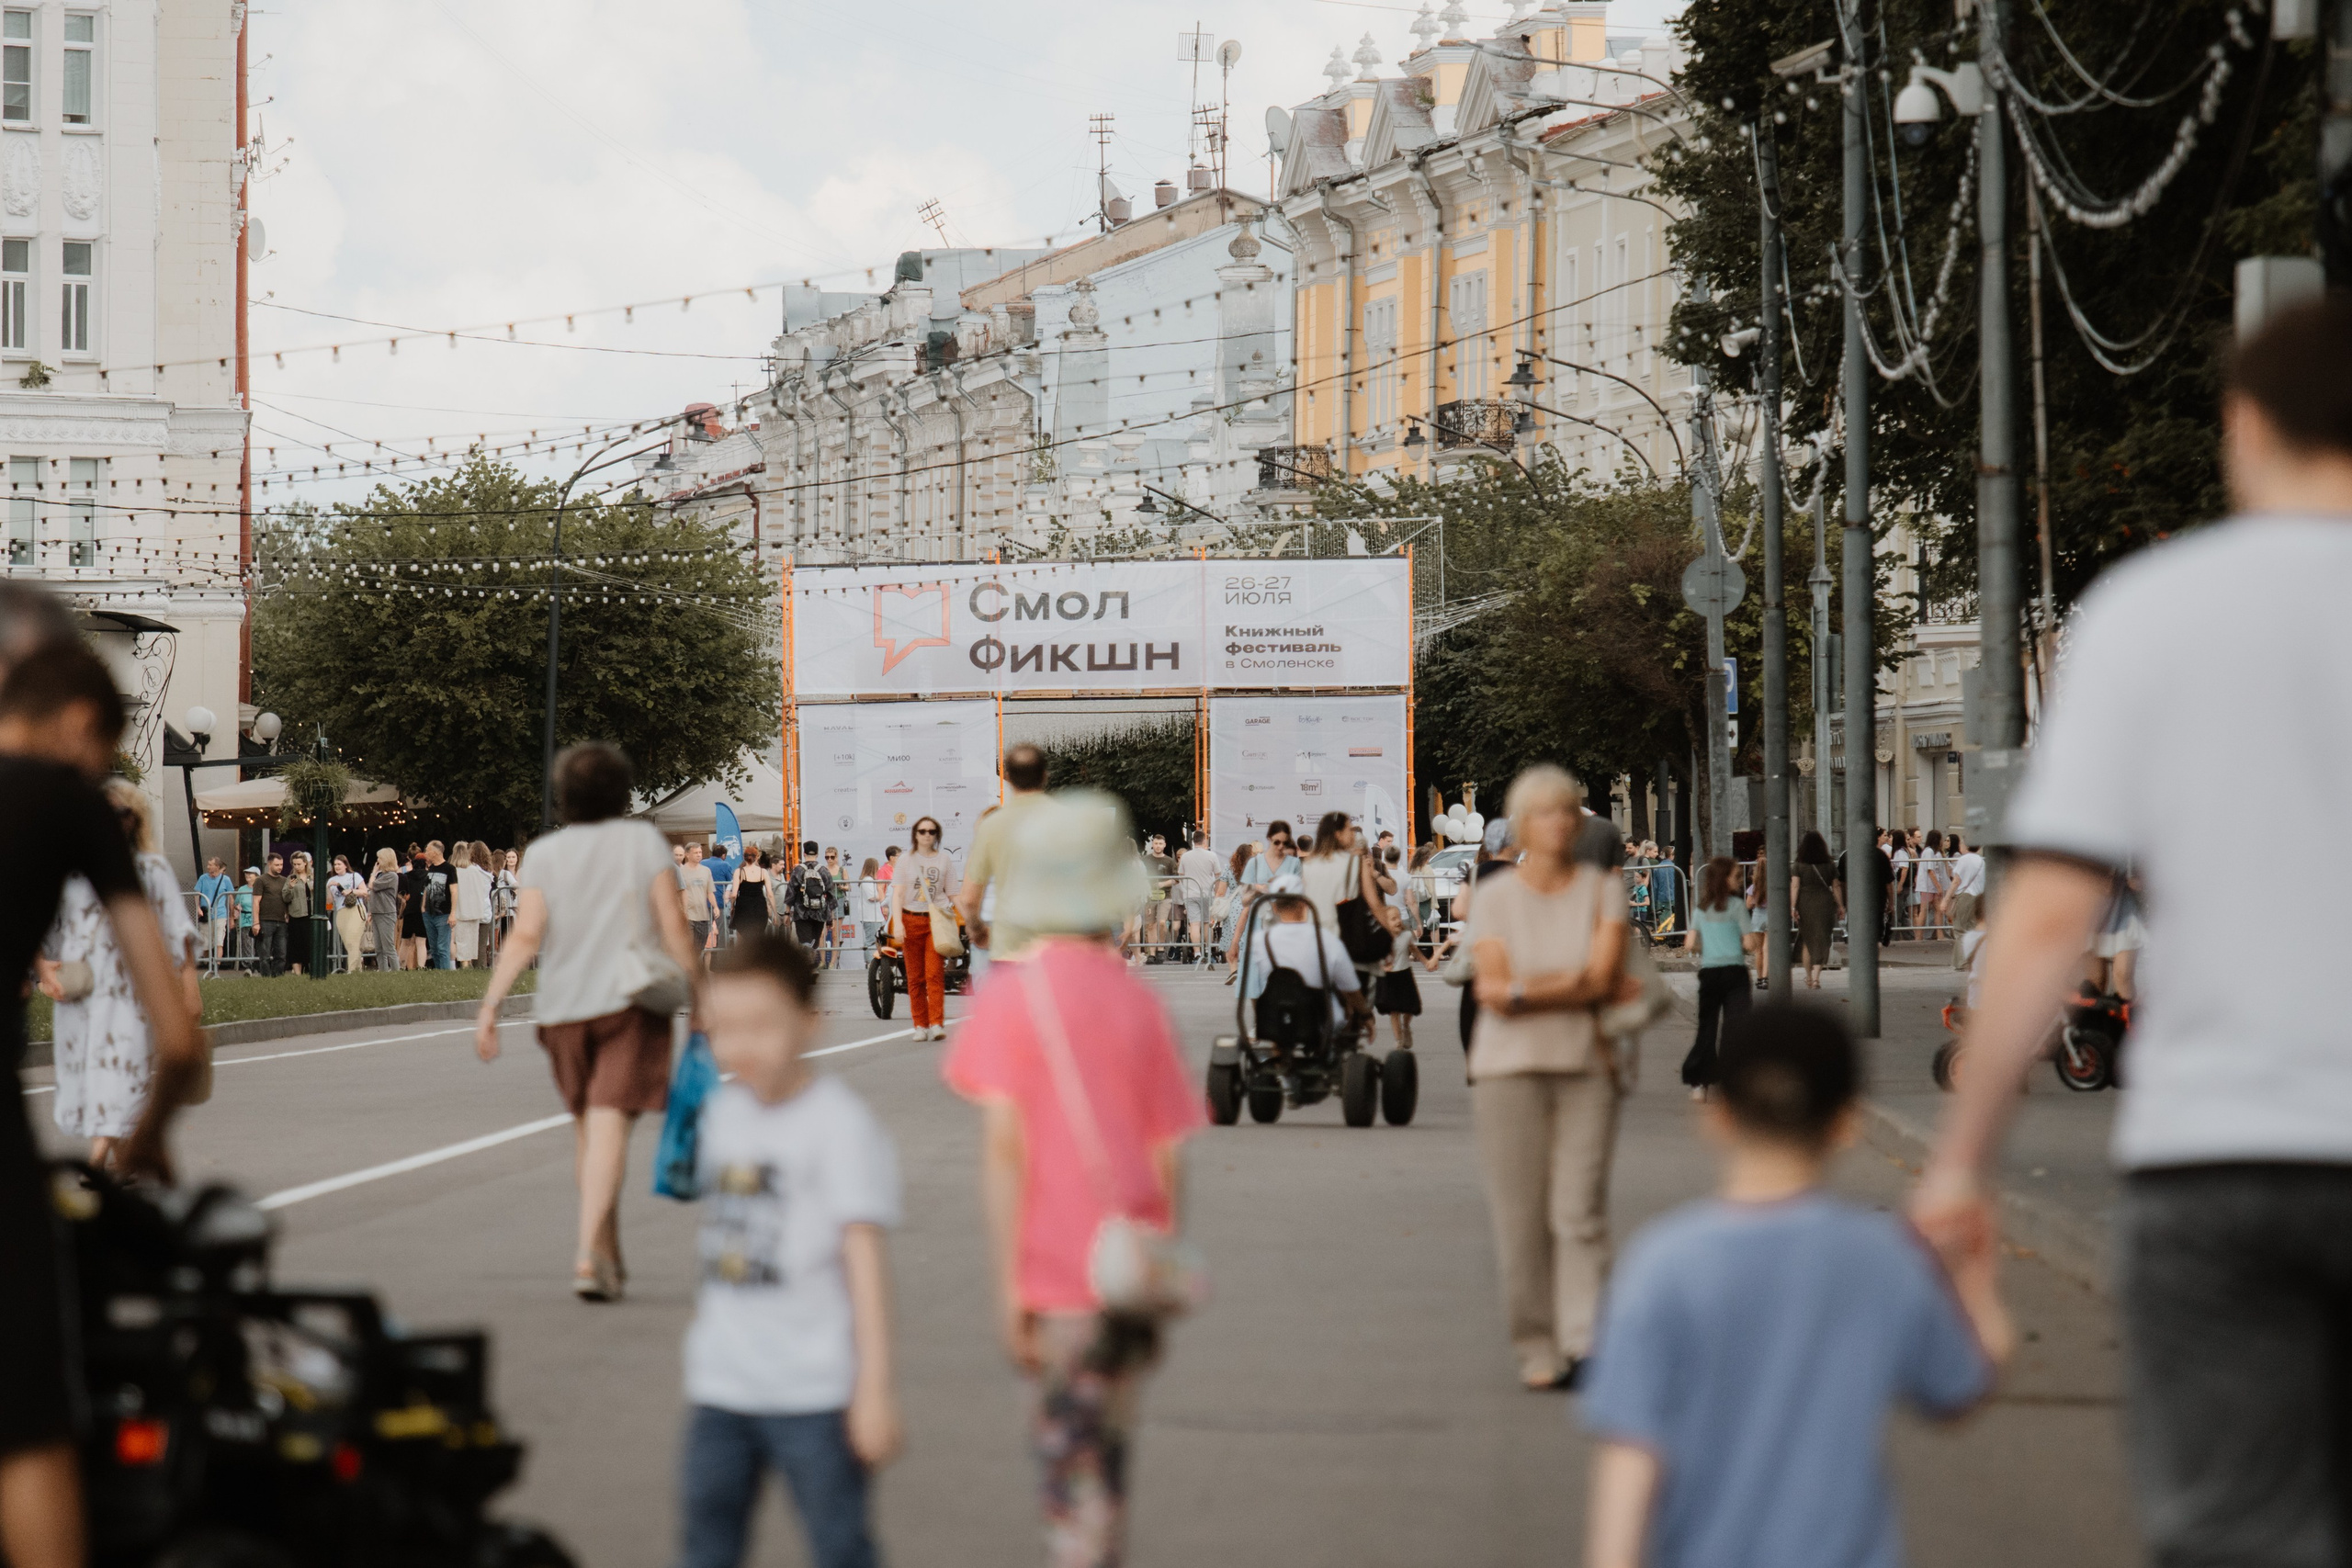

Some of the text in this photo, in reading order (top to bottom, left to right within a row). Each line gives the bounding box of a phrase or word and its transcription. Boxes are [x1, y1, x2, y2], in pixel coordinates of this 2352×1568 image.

[1225, 576, 1292, 590] 26-27
[969, 581, 1129, 622] Смол
[1225, 592, 1292, 604] ИЮЛЯ
[1225, 625, 1324, 637] Книжный
[1225, 642, 1342, 656] фестиваль
[1226, 658, 1335, 669] в Смоленске
